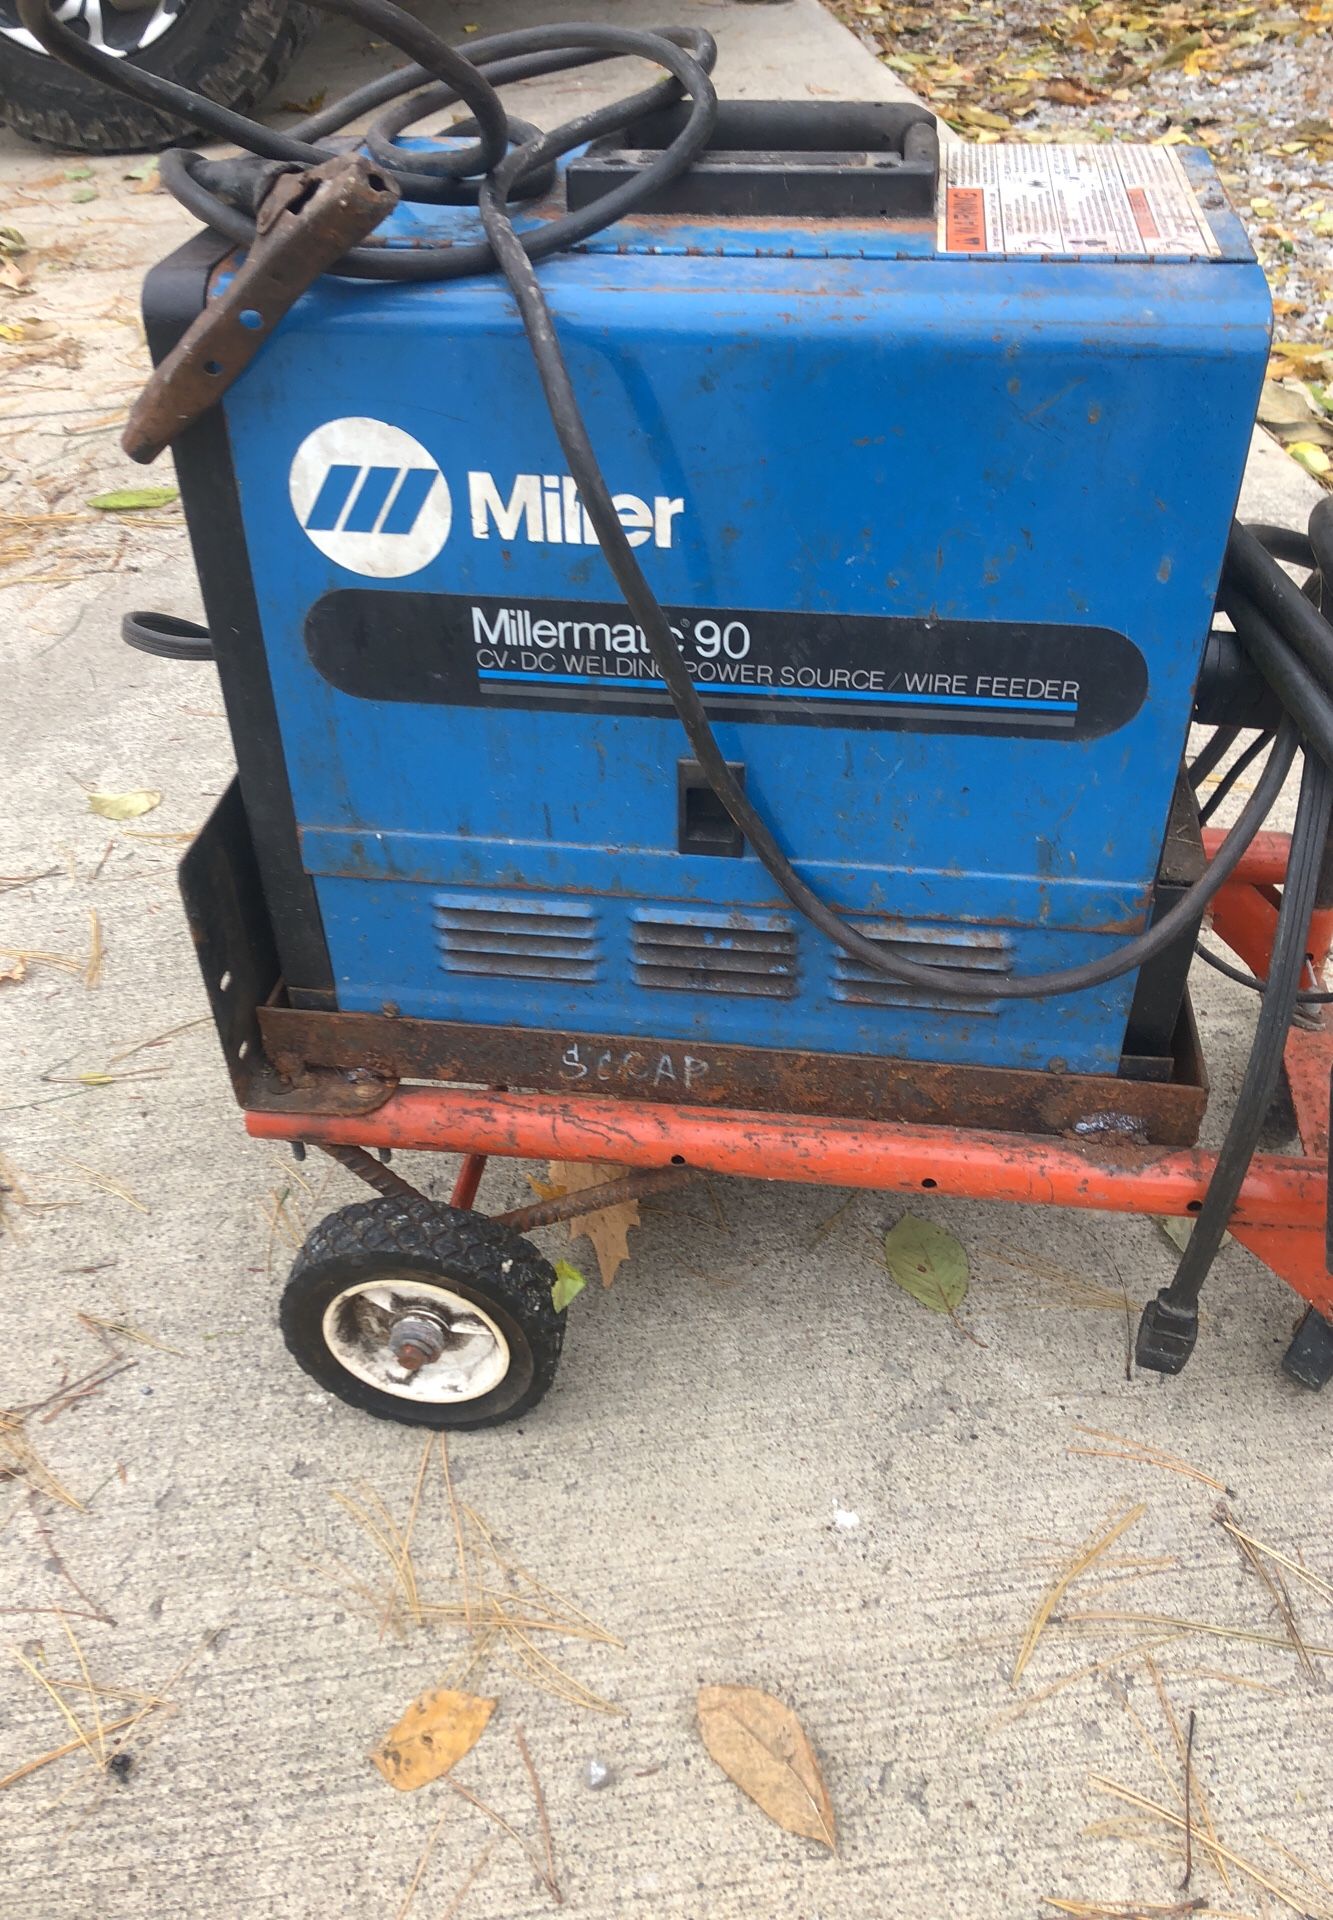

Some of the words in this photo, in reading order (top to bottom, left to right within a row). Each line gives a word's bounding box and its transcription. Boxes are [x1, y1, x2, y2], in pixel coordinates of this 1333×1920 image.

[471, 606, 685, 654] Millermat
[693, 619, 751, 660] 90
[975, 675, 1080, 701] FEEDER
